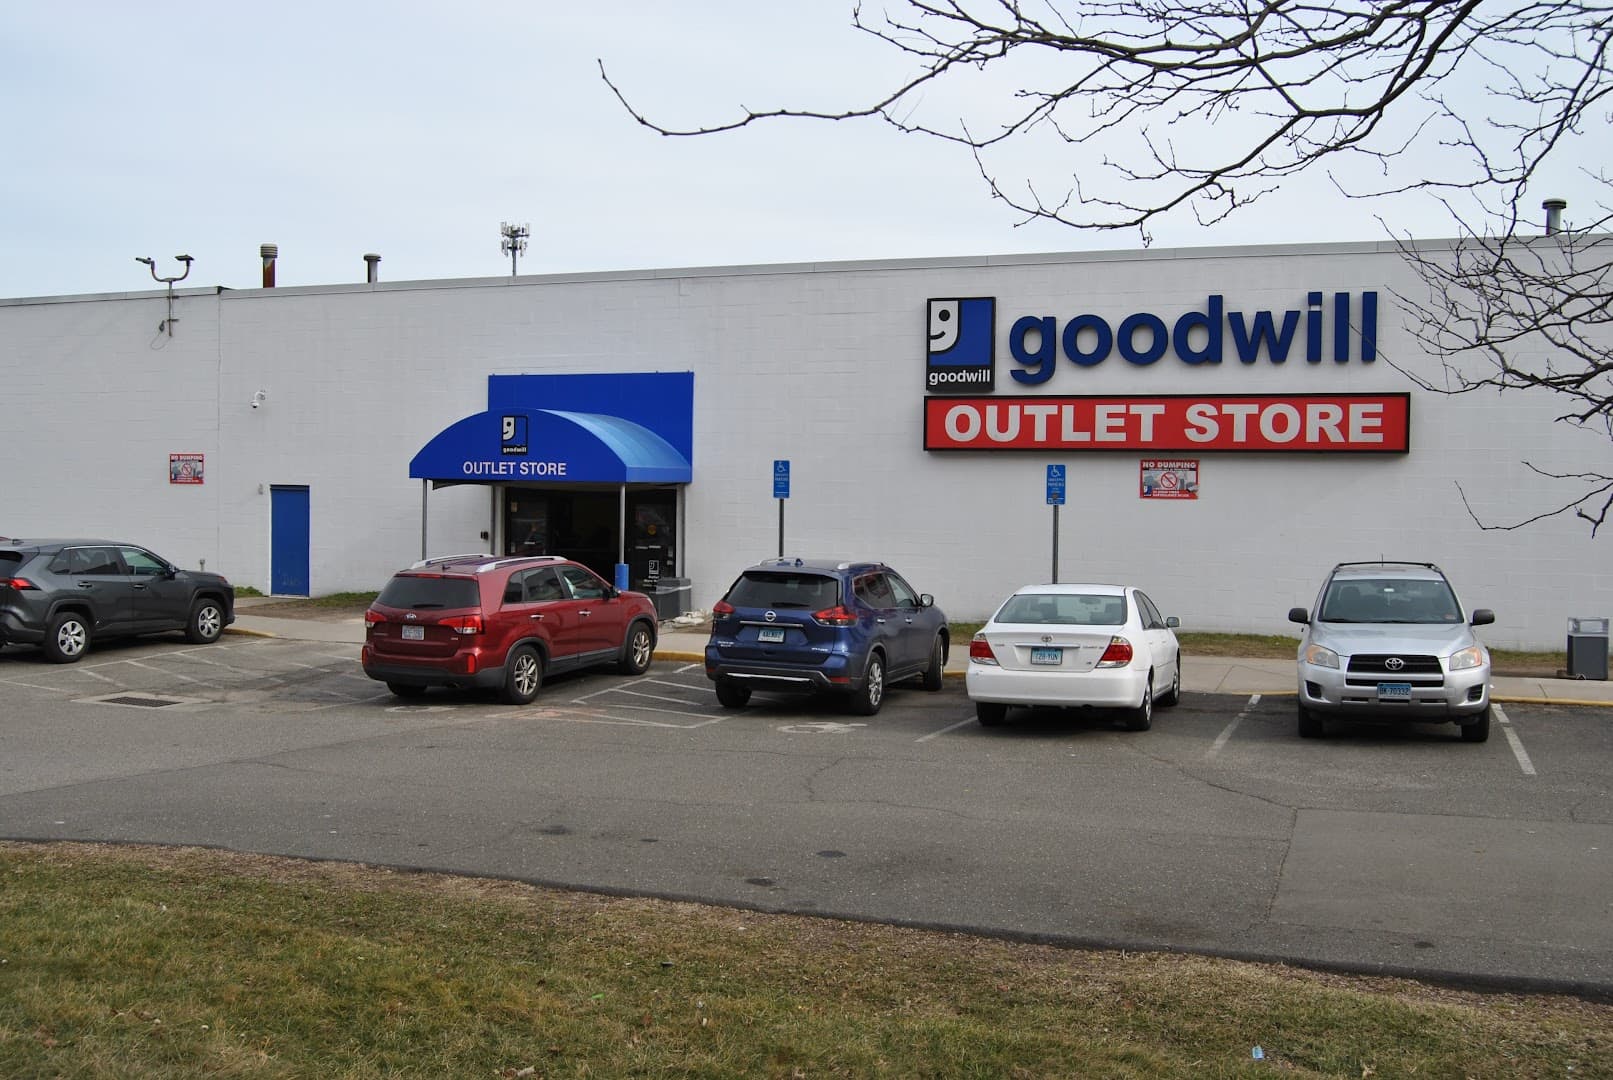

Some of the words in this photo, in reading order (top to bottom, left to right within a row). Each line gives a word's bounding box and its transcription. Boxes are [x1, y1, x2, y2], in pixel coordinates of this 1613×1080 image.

[1009, 291, 1378, 386] goodwill
[928, 369, 991, 386] goodwill
[944, 403, 1165, 443] OUTLET
[1184, 403, 1385, 443] STORE
[462, 461, 517, 475] OUTLET
[519, 462, 567, 476] STORE
